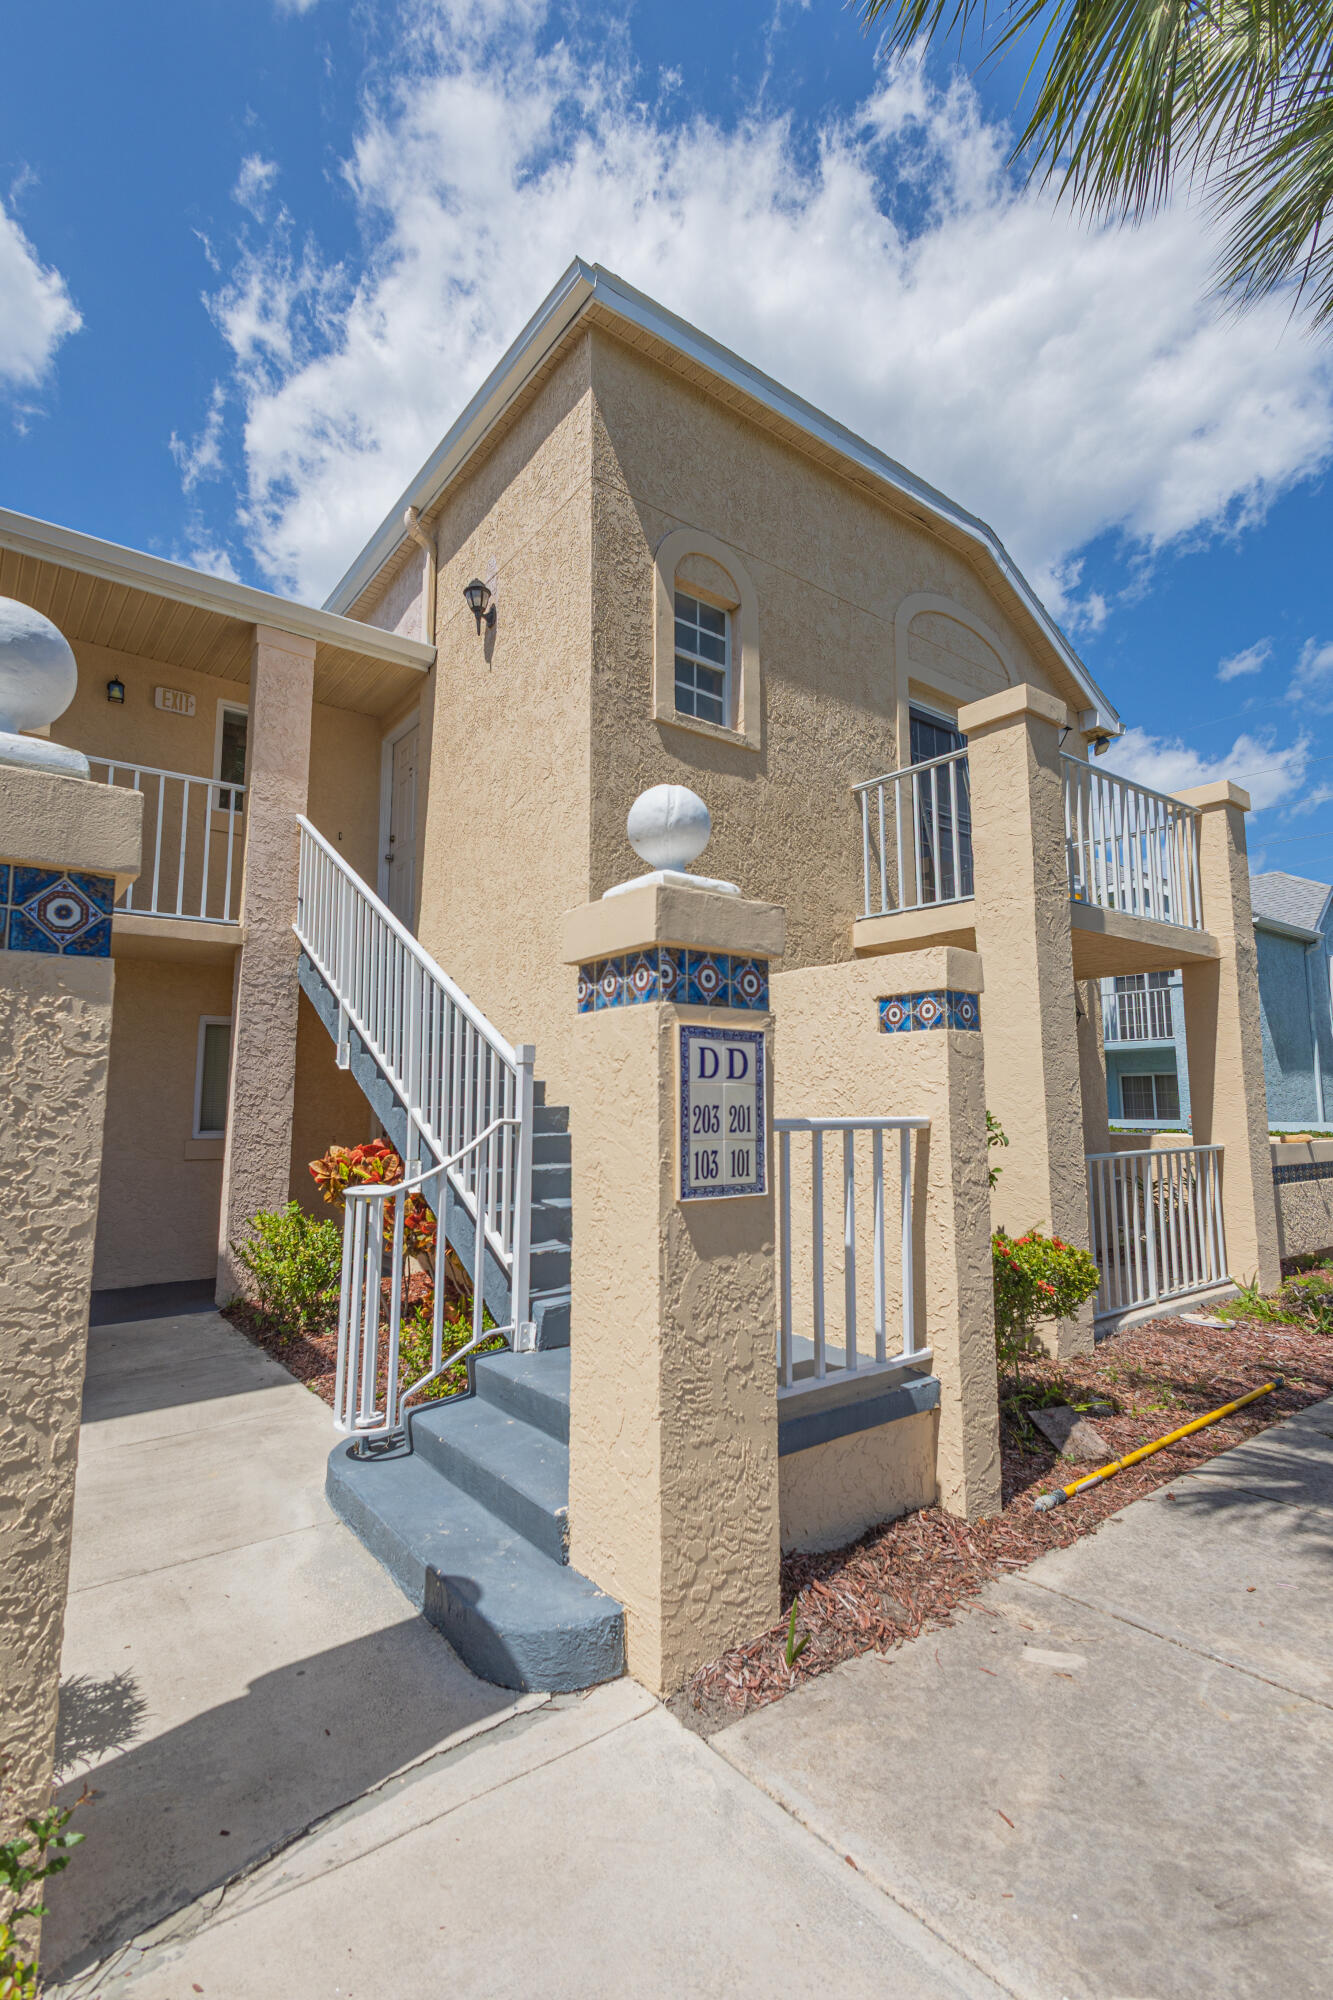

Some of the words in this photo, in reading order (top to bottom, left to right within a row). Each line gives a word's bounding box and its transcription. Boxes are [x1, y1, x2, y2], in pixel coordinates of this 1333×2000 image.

[162, 688, 191, 713] EXIT
[698, 1047, 719, 1079] D
[726, 1048, 748, 1079] D
[693, 1105, 720, 1134] 203
[729, 1105, 751, 1133] 201
[694, 1150, 719, 1180] 103
[731, 1149, 750, 1178] 101
